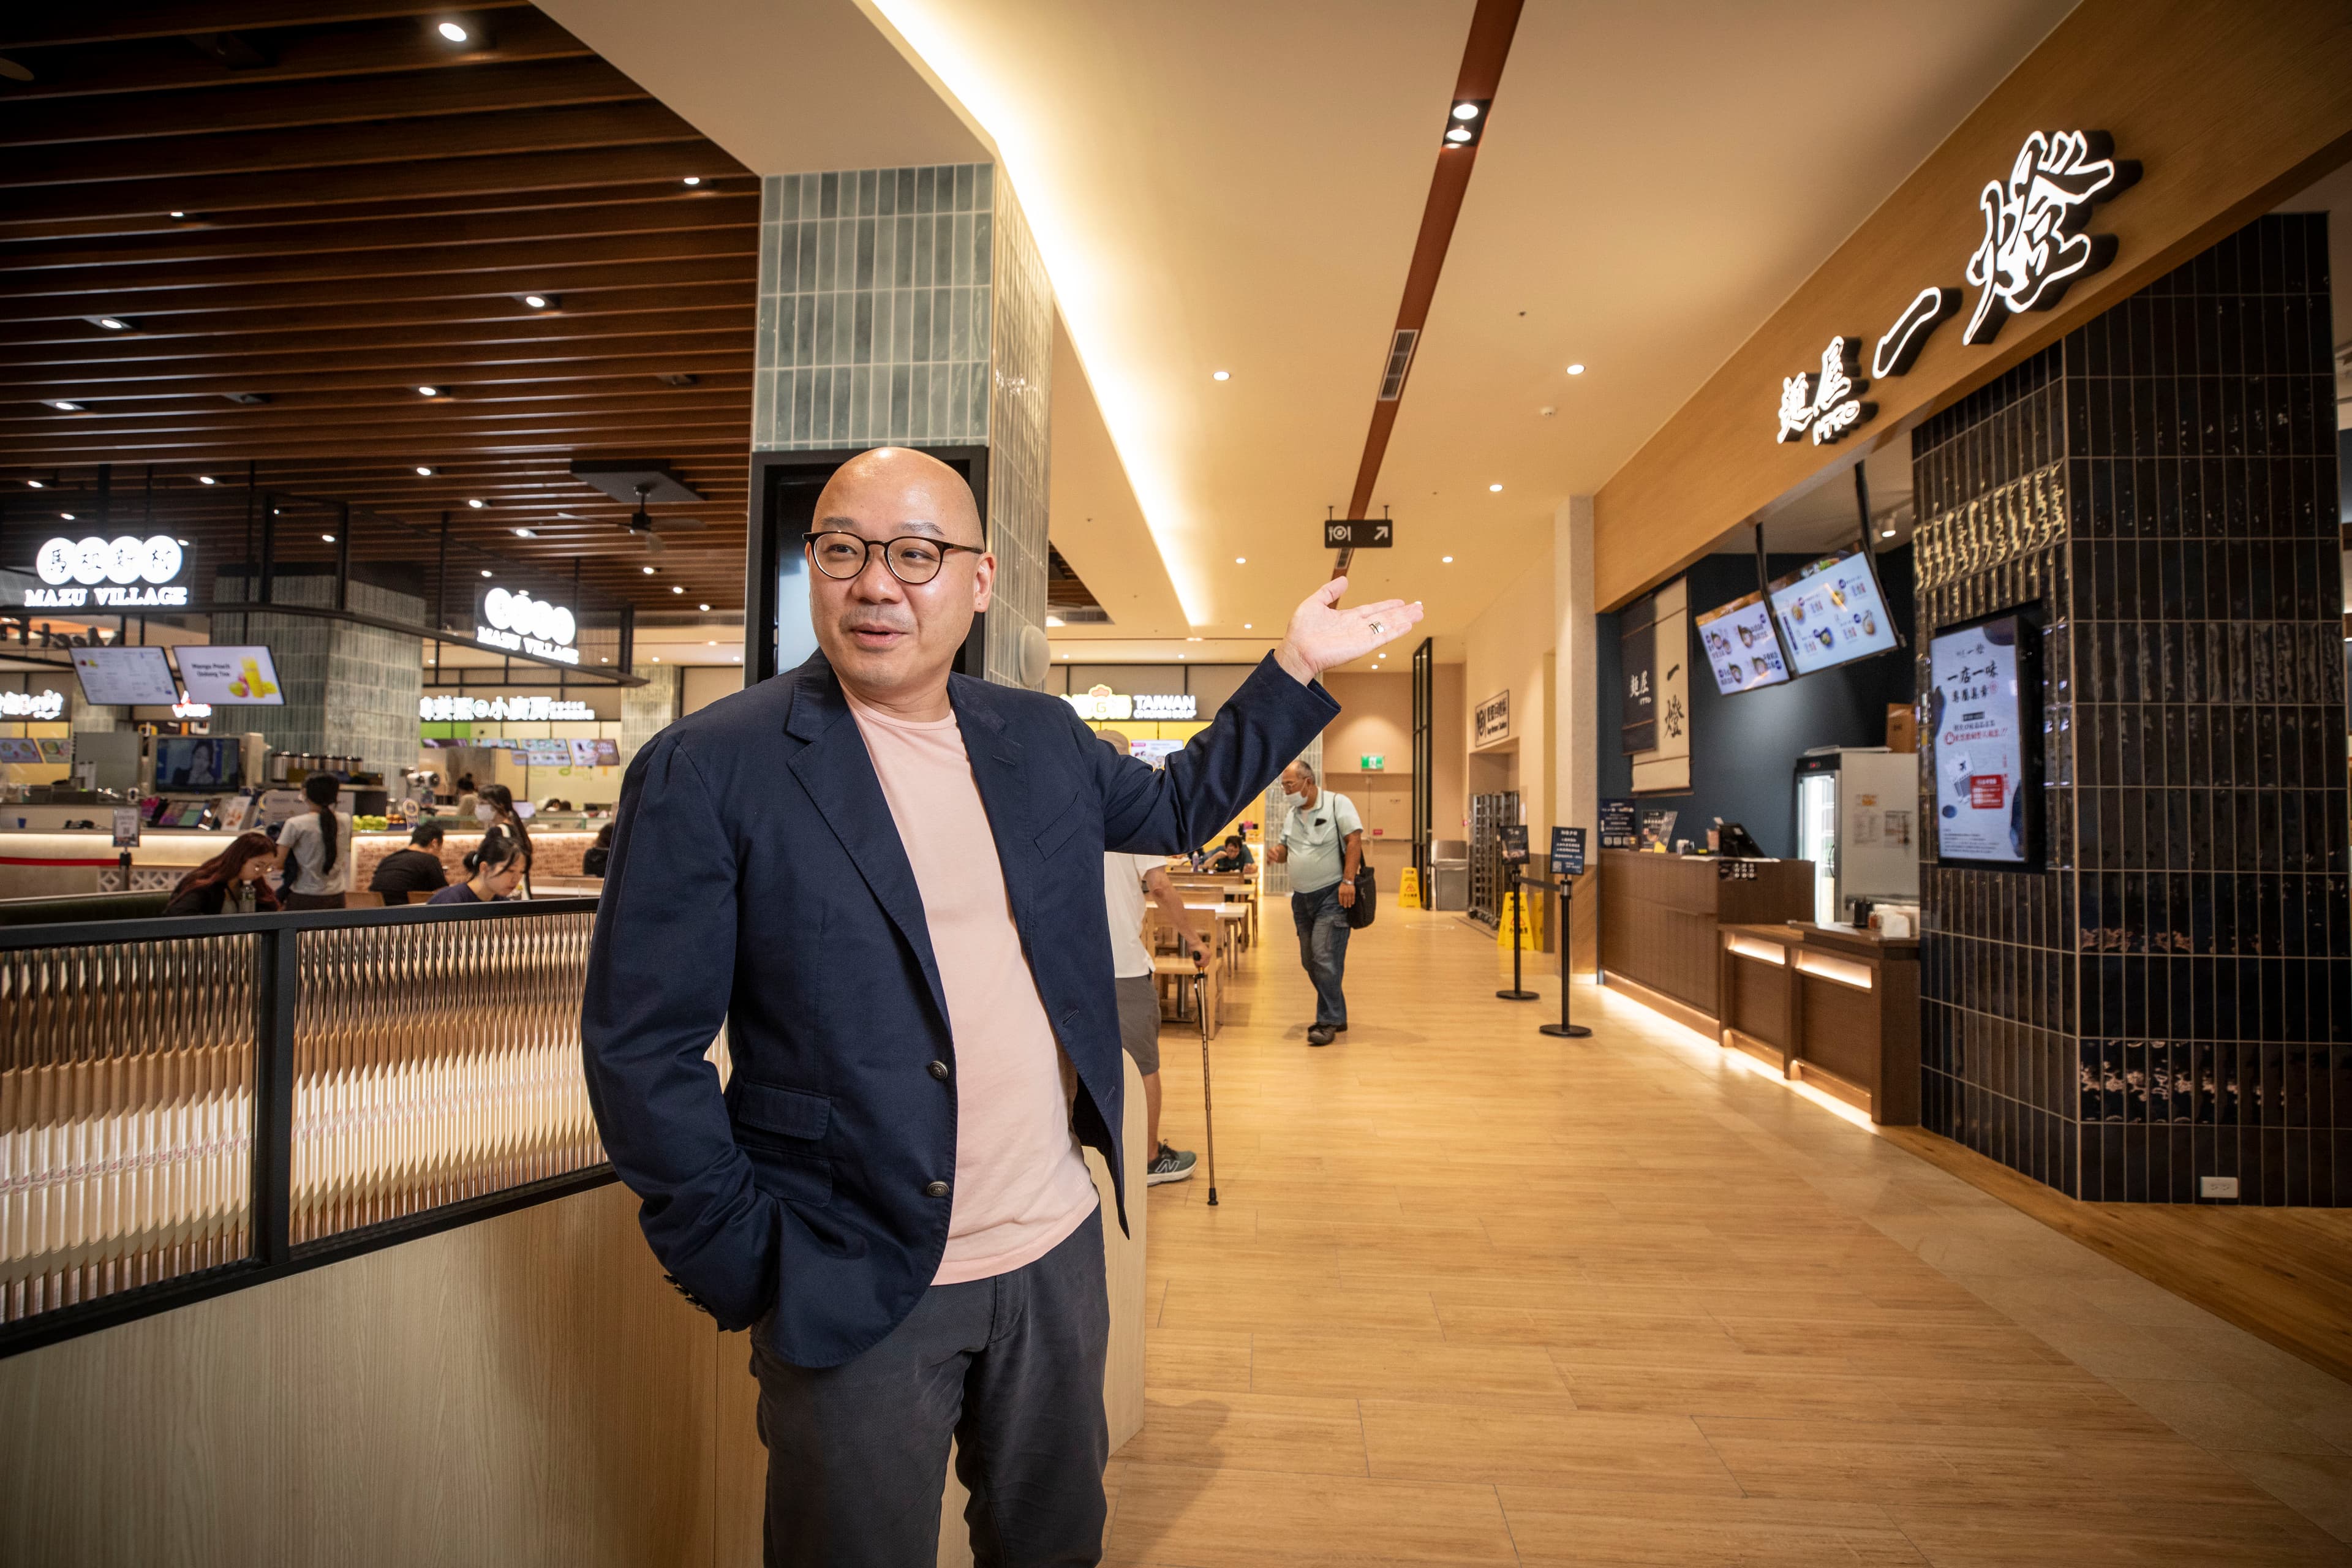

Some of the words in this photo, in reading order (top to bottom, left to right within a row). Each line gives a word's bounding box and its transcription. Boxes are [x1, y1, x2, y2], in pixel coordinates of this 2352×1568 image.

[24, 588, 88, 606] MAZU
[94, 587, 187, 605] VILLAGE
[1133, 695, 1196, 710] TAIWAN
